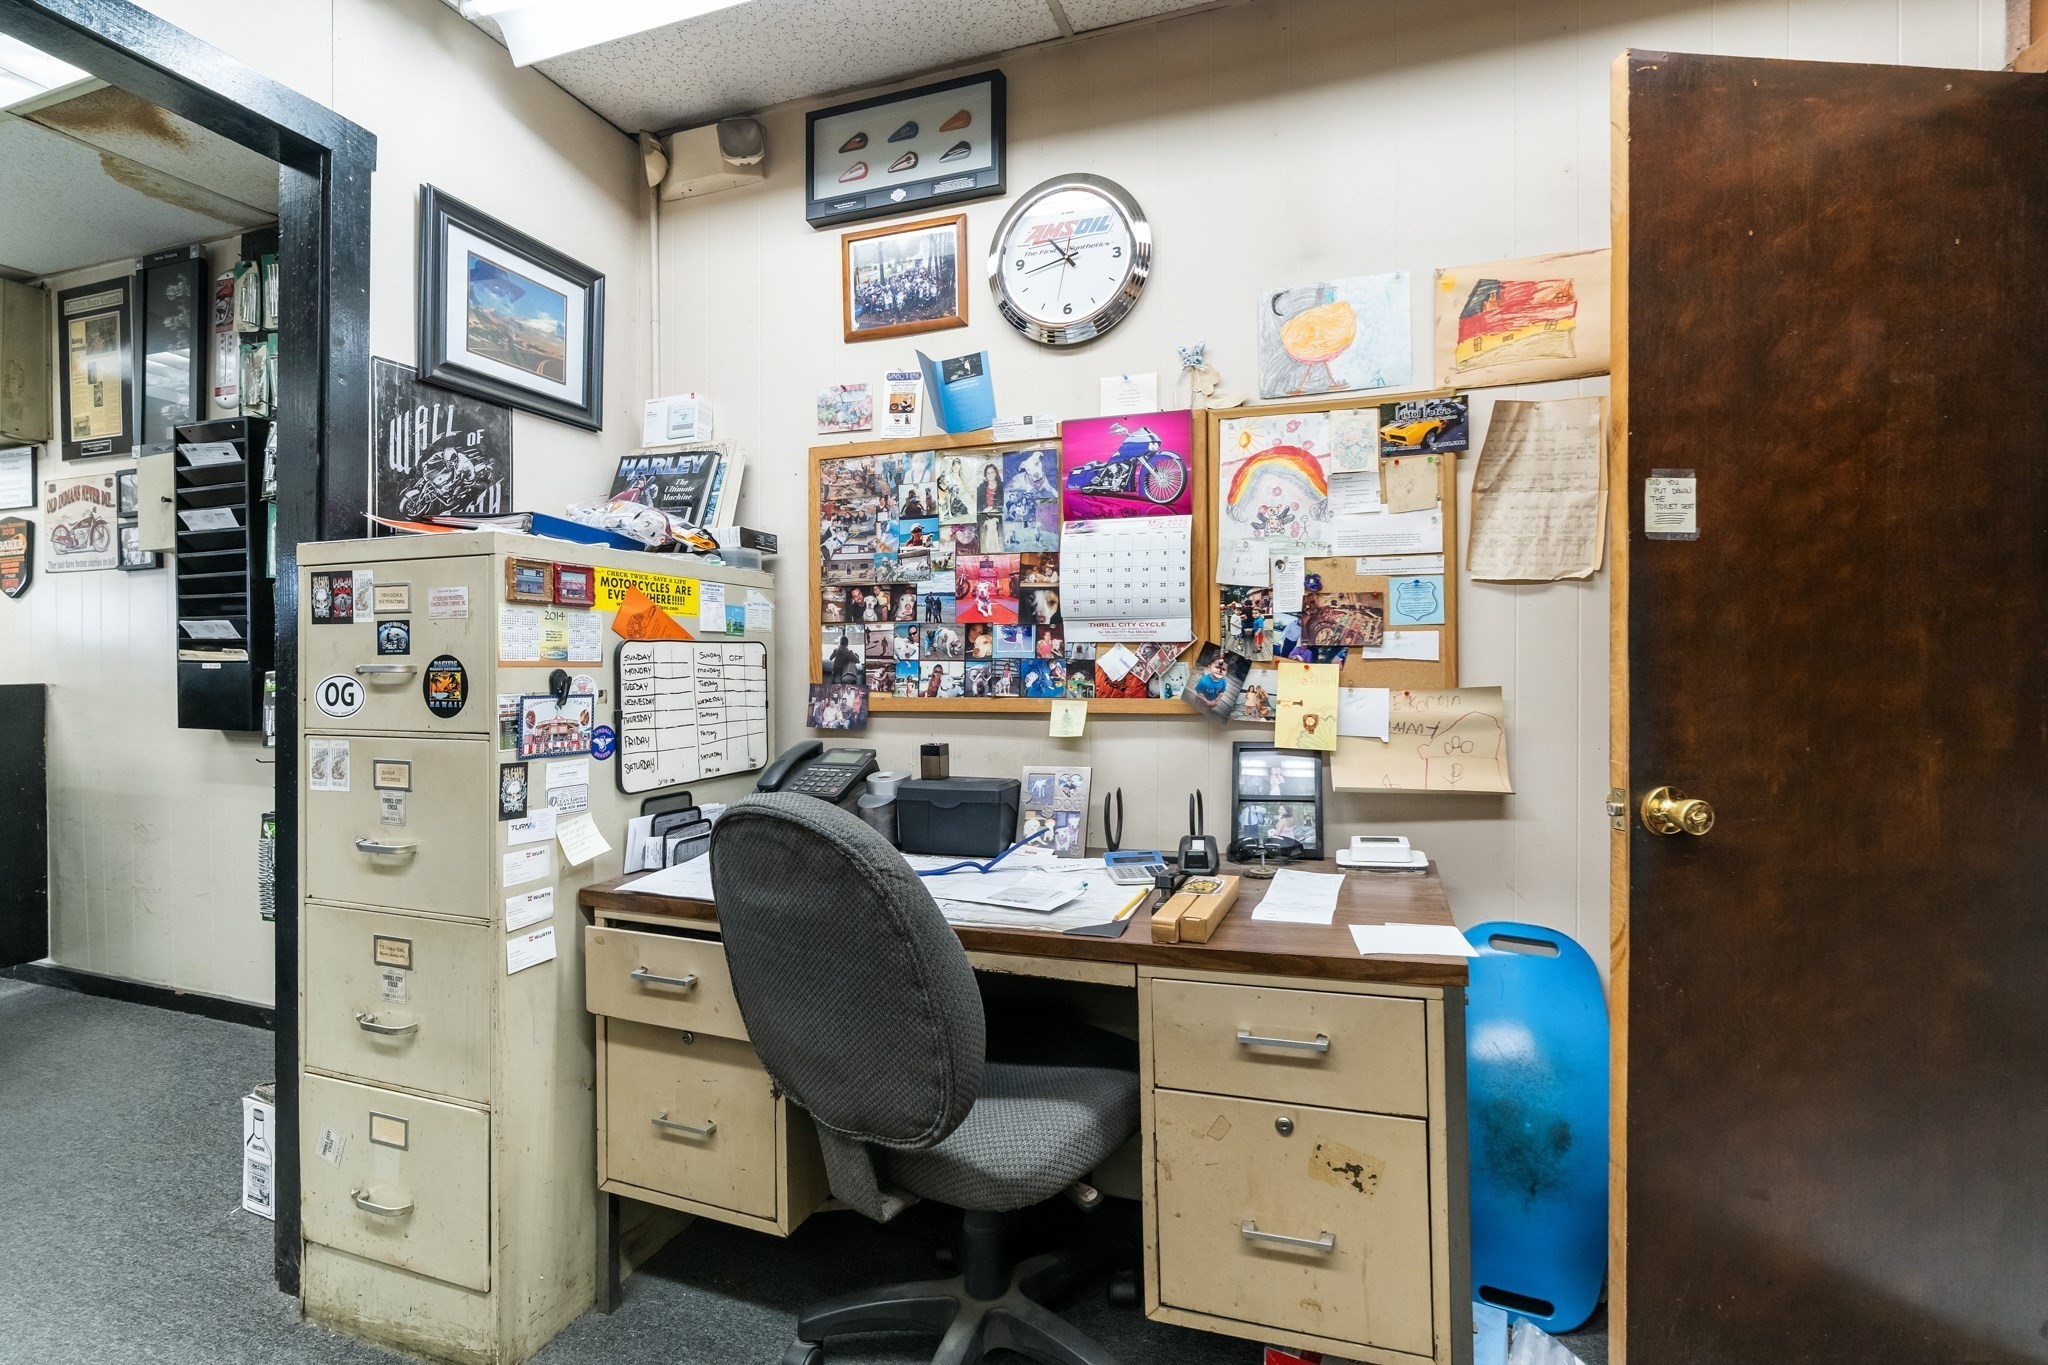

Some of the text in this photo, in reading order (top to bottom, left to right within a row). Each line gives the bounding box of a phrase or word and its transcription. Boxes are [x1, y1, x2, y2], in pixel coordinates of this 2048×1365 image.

[1023, 215, 1115, 245] AMSOIL
[1112, 246, 1122, 258] 3
[1015, 259, 1025, 271] 9
[1063, 303, 1072, 315] 6
[389, 403, 462, 475] WALL
[466, 429, 485, 447] OF
[618, 455, 708, 476] HARLEY
[675, 478, 689, 486] The
[664, 485, 695, 493] Ultimate
[1672, 486, 1692, 494] DOWN
[662, 493, 692, 501] Machine
[1147, 520, 1165, 528] May
[607, 570, 628, 578] CHECK
[630, 573, 648, 581] TWICE
[600, 576, 670, 593] MOTORCYCLES
[675, 586, 692, 595] ARE
[544, 610, 565, 621] 2014
[624, 651, 652, 661] SUNDAY
[729, 654, 744, 662] OFF
[625, 666, 651, 676] MONDAY
[622, 682, 648, 691] TUESDAY
[325, 682, 354, 707] OG
[622, 712, 652, 725] THURSDAY
[624, 735, 649, 748] FRIDAY
[624, 758, 655, 775] SATURDAY
